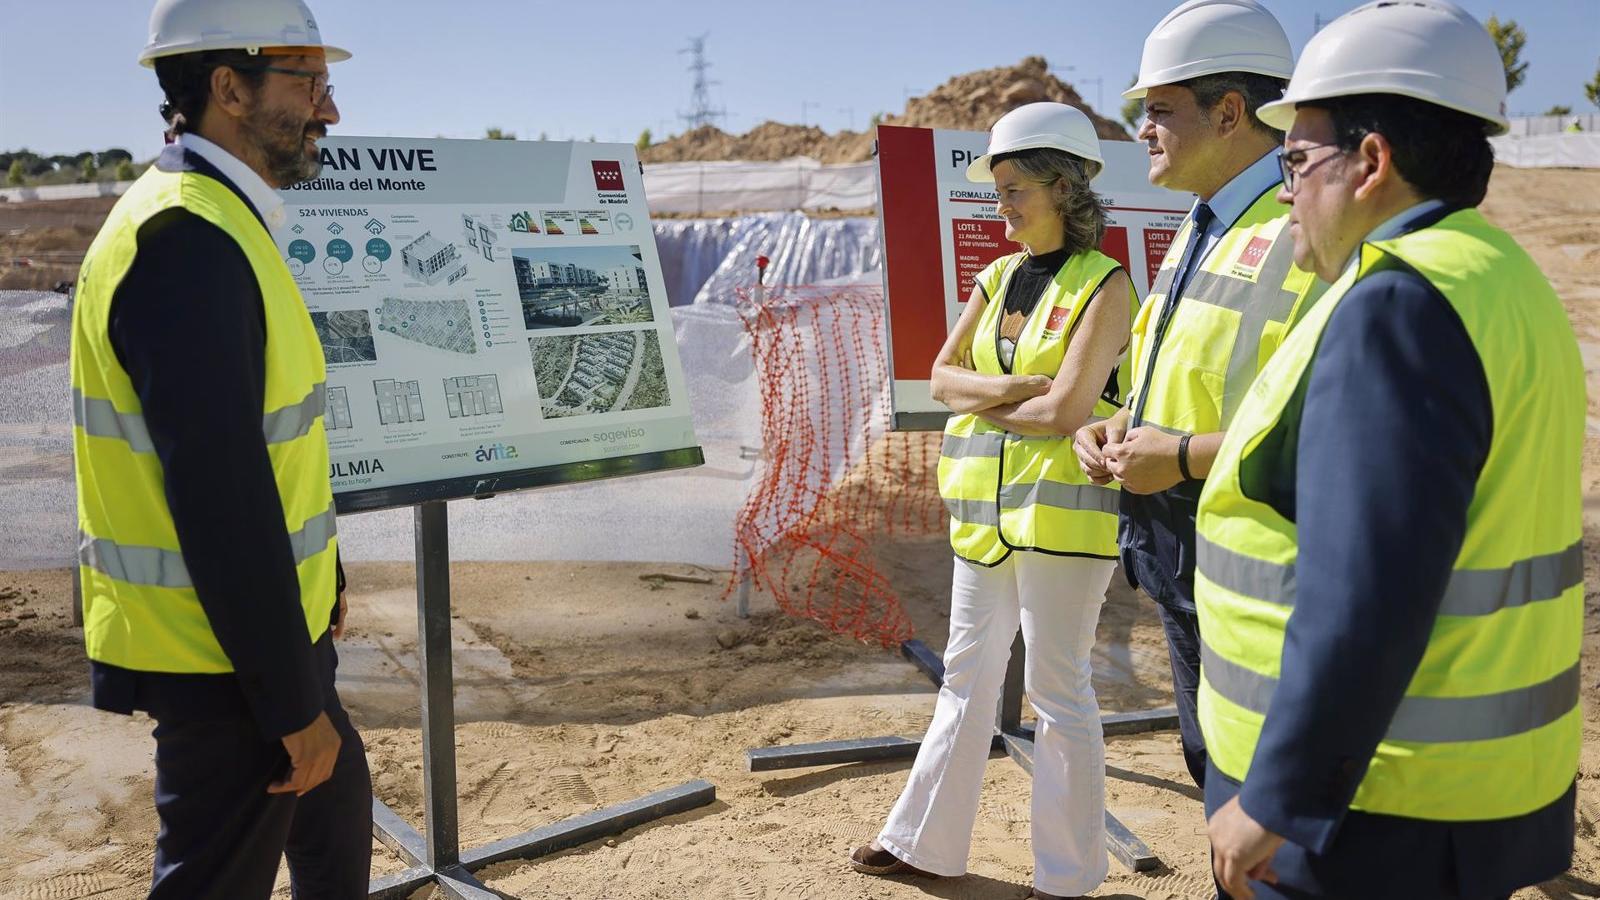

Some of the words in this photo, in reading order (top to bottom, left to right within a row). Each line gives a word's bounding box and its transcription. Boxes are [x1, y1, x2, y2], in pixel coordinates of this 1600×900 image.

[319, 148, 361, 170] AN
[368, 148, 437, 171] VIVE
[280, 178, 345, 190] oadilla
[349, 178, 373, 190] del
[377, 178, 426, 190] Monte
[300, 208, 316, 216] 524
[318, 208, 368, 216] VIVIENDAS
[593, 427, 645, 442] sogeviso
[329, 458, 384, 478] ULMIA
